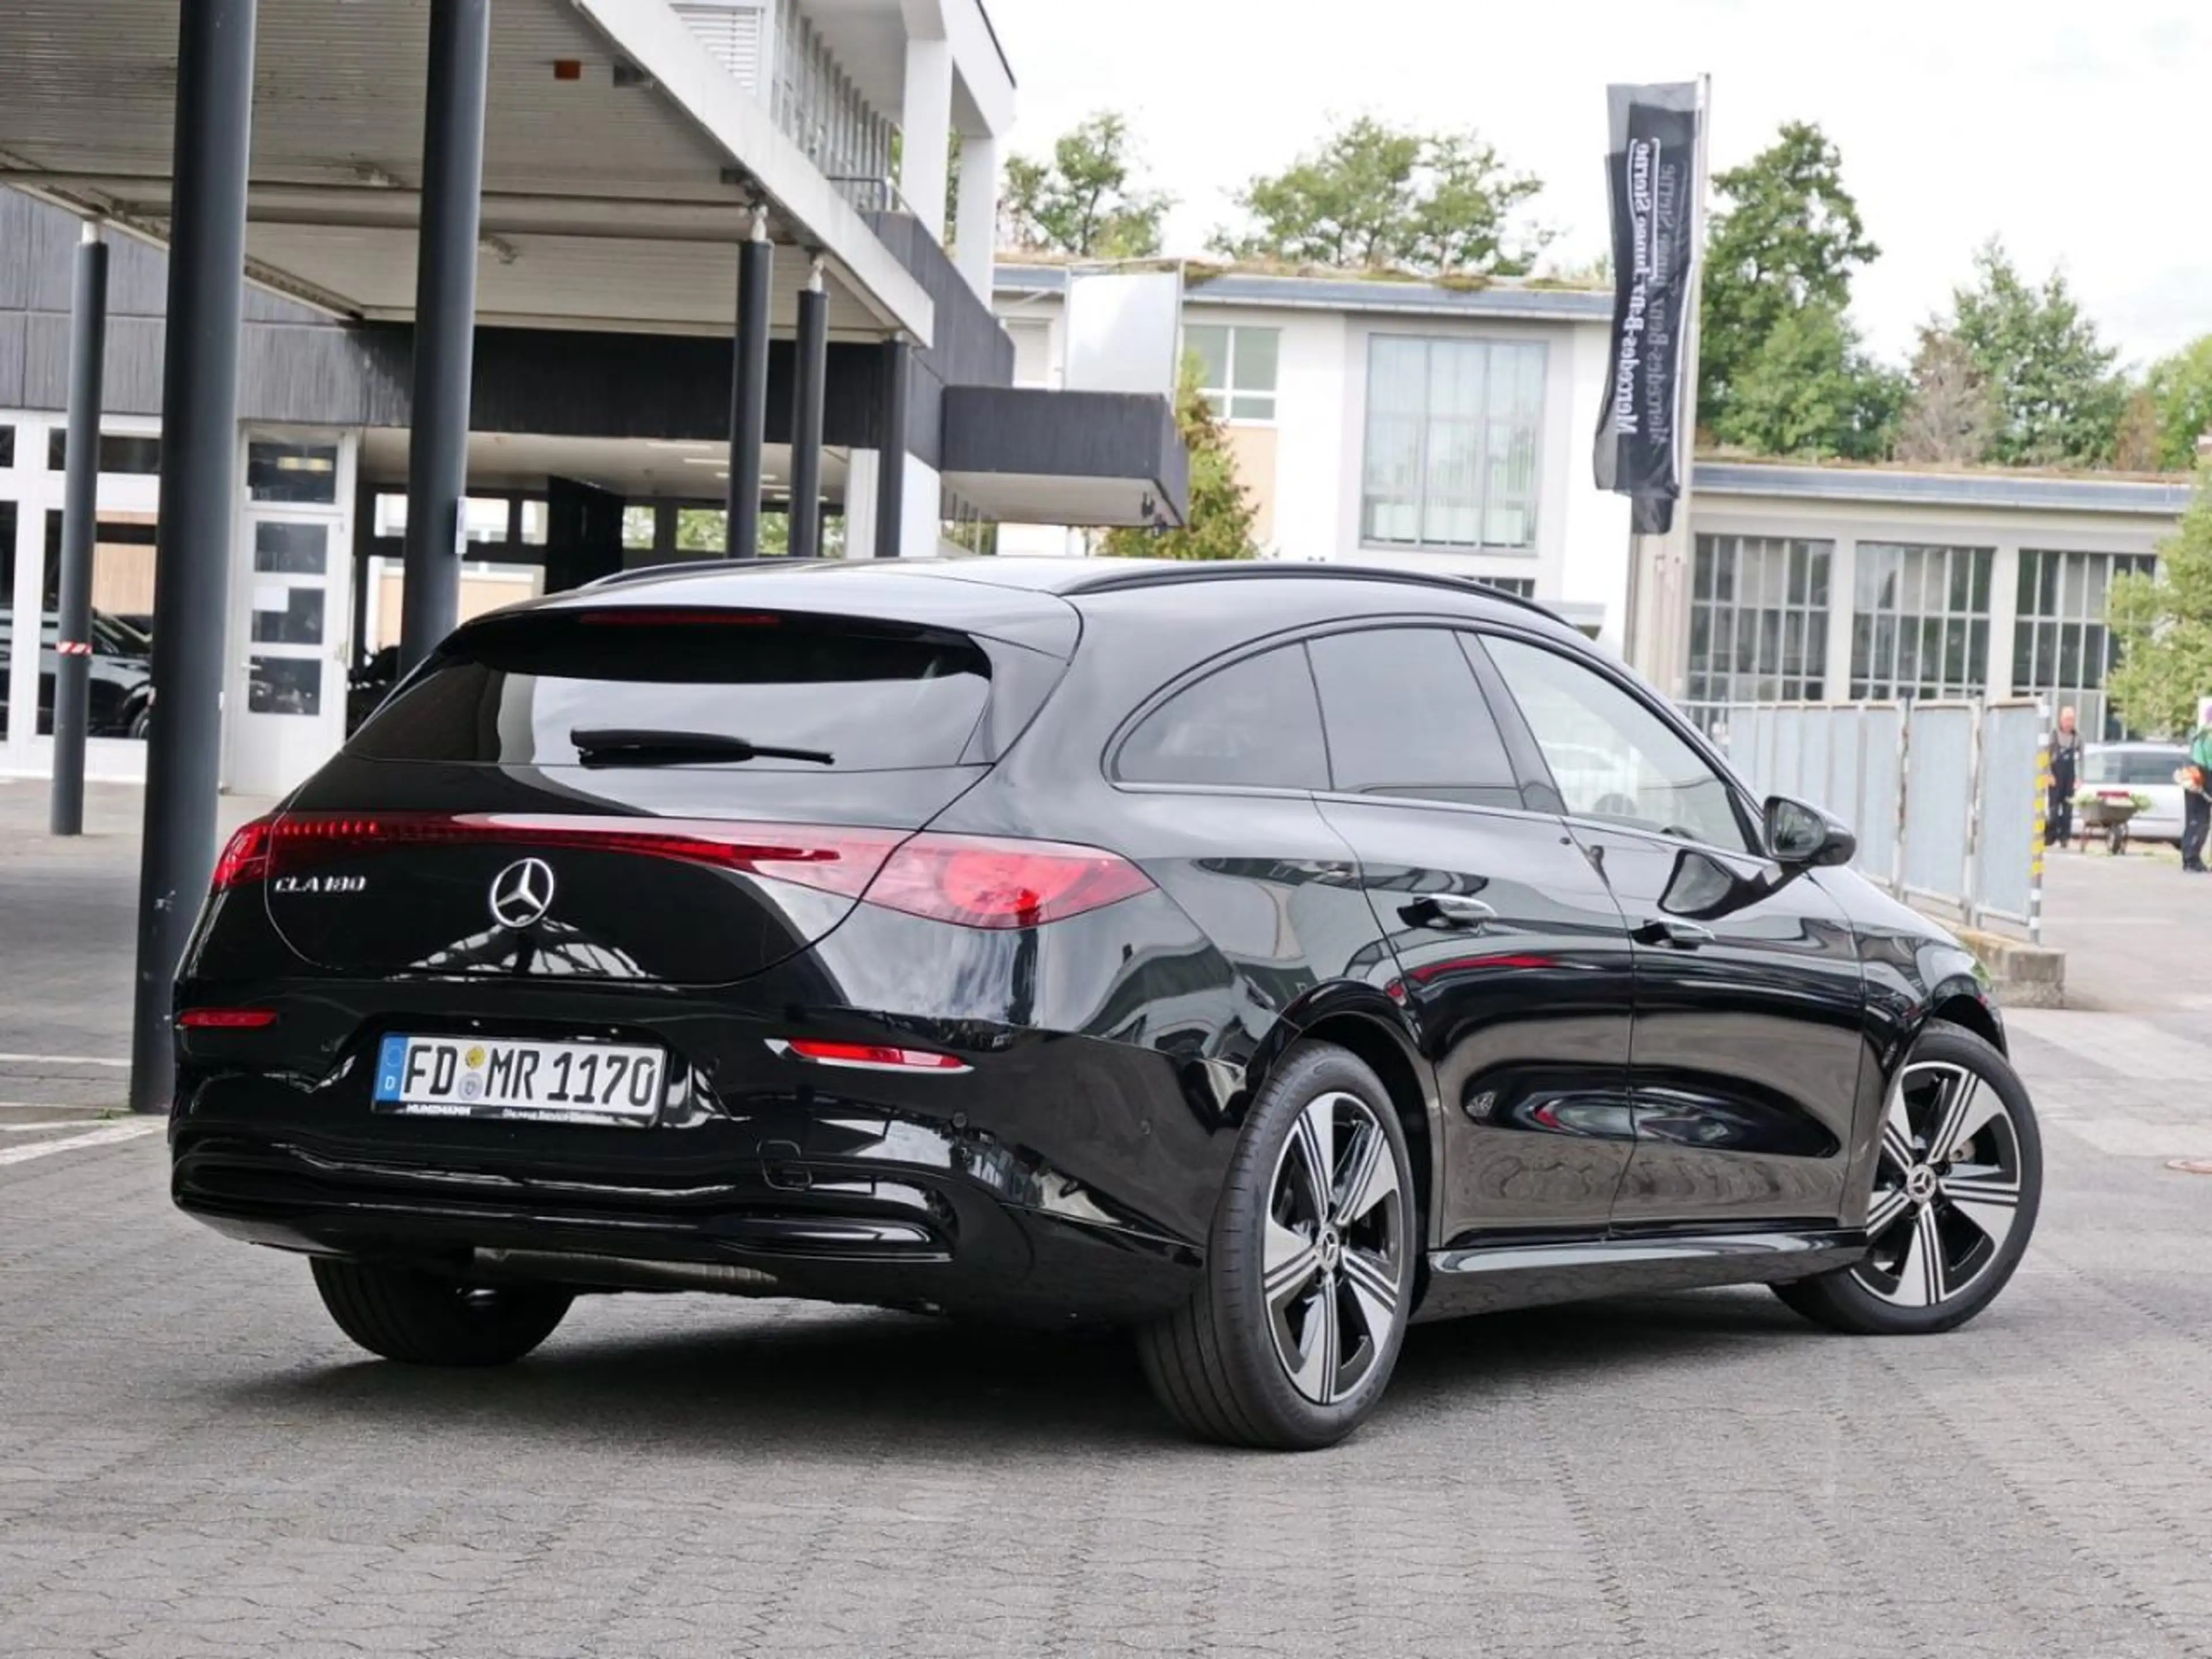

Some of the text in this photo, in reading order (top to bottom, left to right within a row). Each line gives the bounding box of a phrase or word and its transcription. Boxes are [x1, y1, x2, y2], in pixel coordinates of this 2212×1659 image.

[274, 876, 366, 892] CLA 180
[384, 1075, 397, 1091] D
[404, 1044, 656, 1107] FD MR 1170
